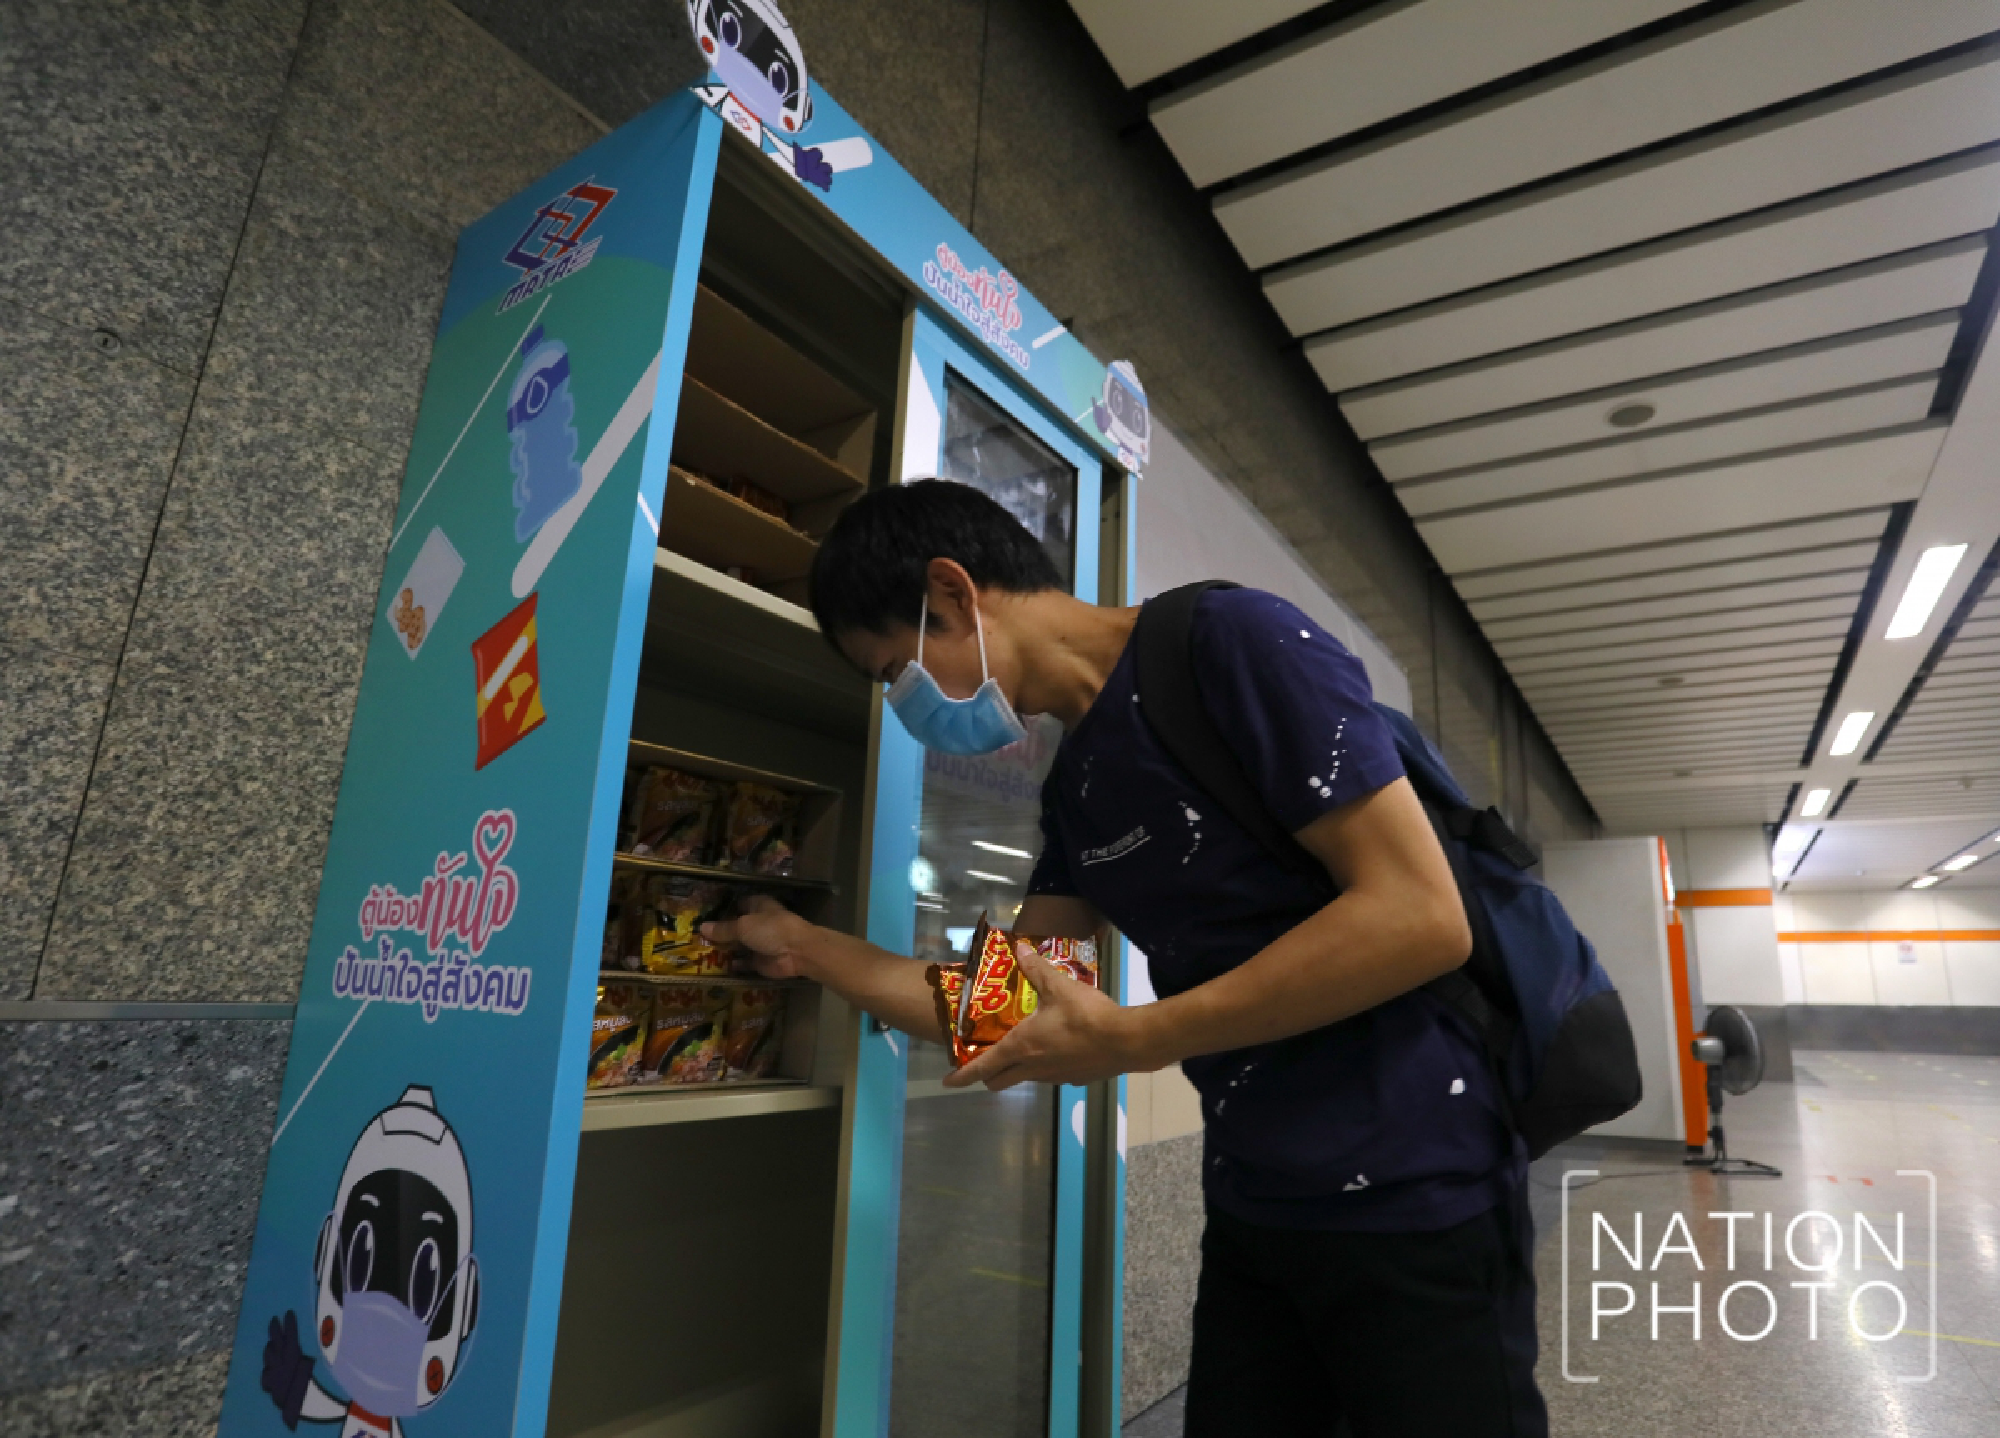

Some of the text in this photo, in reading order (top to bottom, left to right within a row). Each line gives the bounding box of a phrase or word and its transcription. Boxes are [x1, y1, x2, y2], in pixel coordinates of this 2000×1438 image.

[333, 935, 532, 1022] ปันน้ำใจสู่สังคม
